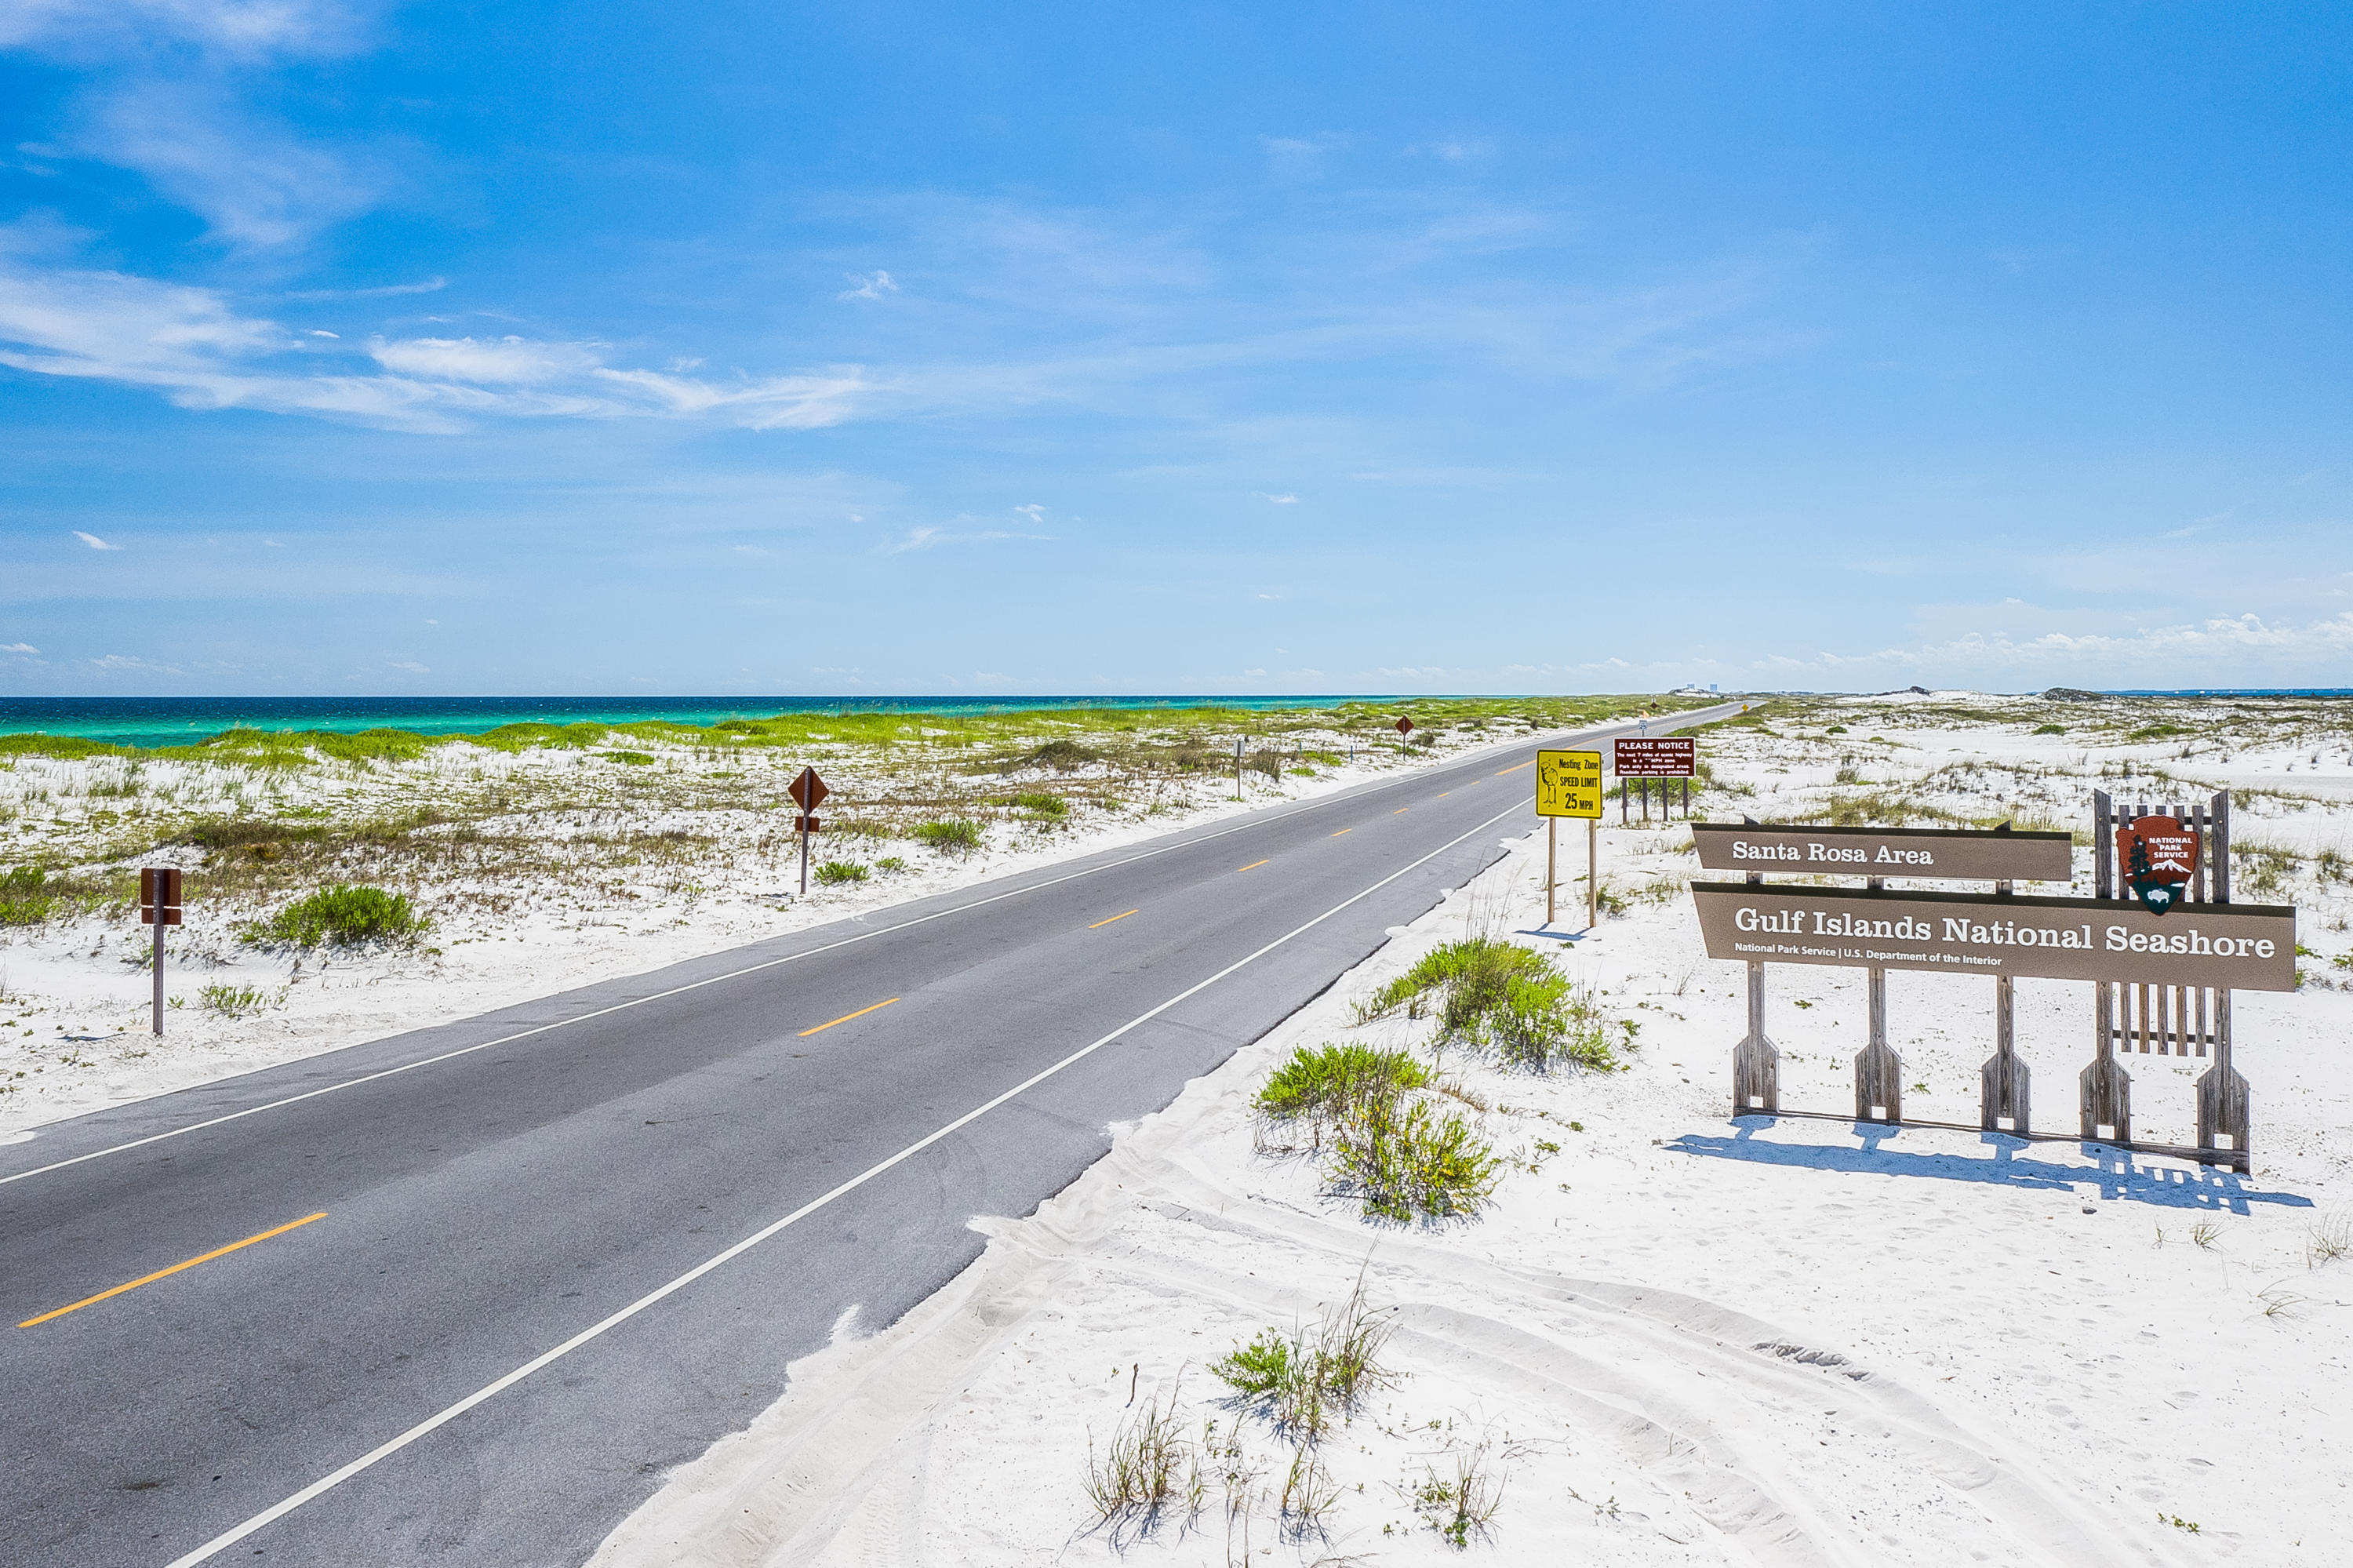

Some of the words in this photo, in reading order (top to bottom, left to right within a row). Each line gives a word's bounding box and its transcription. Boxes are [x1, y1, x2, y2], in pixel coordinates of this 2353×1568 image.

[1559, 759, 1581, 770] Nesting
[1584, 759, 1598, 769] Zone
[1560, 777, 1579, 788] SPEED
[1581, 777, 1597, 788] LIMIT
[1566, 793, 1577, 809] 25
[1580, 800, 1593, 809] MPH
[1733, 841, 1800, 860] Santa
[1807, 843, 1867, 863] Rosa
[1874, 845, 1934, 865] Area
[1735, 908, 1806, 933] Gulf
[1813, 911, 1932, 940] Islands
[1942, 918, 2093, 950] National
[2105, 926, 2275, 959] Seashore
[1735, 942, 1776, 953] National
[1777, 944, 1799, 955] Park
[1802, 945, 1836, 957] Service
[1844, 948, 1864, 959] U.S.
[1866, 950, 1927, 962] Department
[1929, 952, 1940, 962] of
[1943, 953, 1960, 964] the
[1962, 955, 2002, 966] Interior
